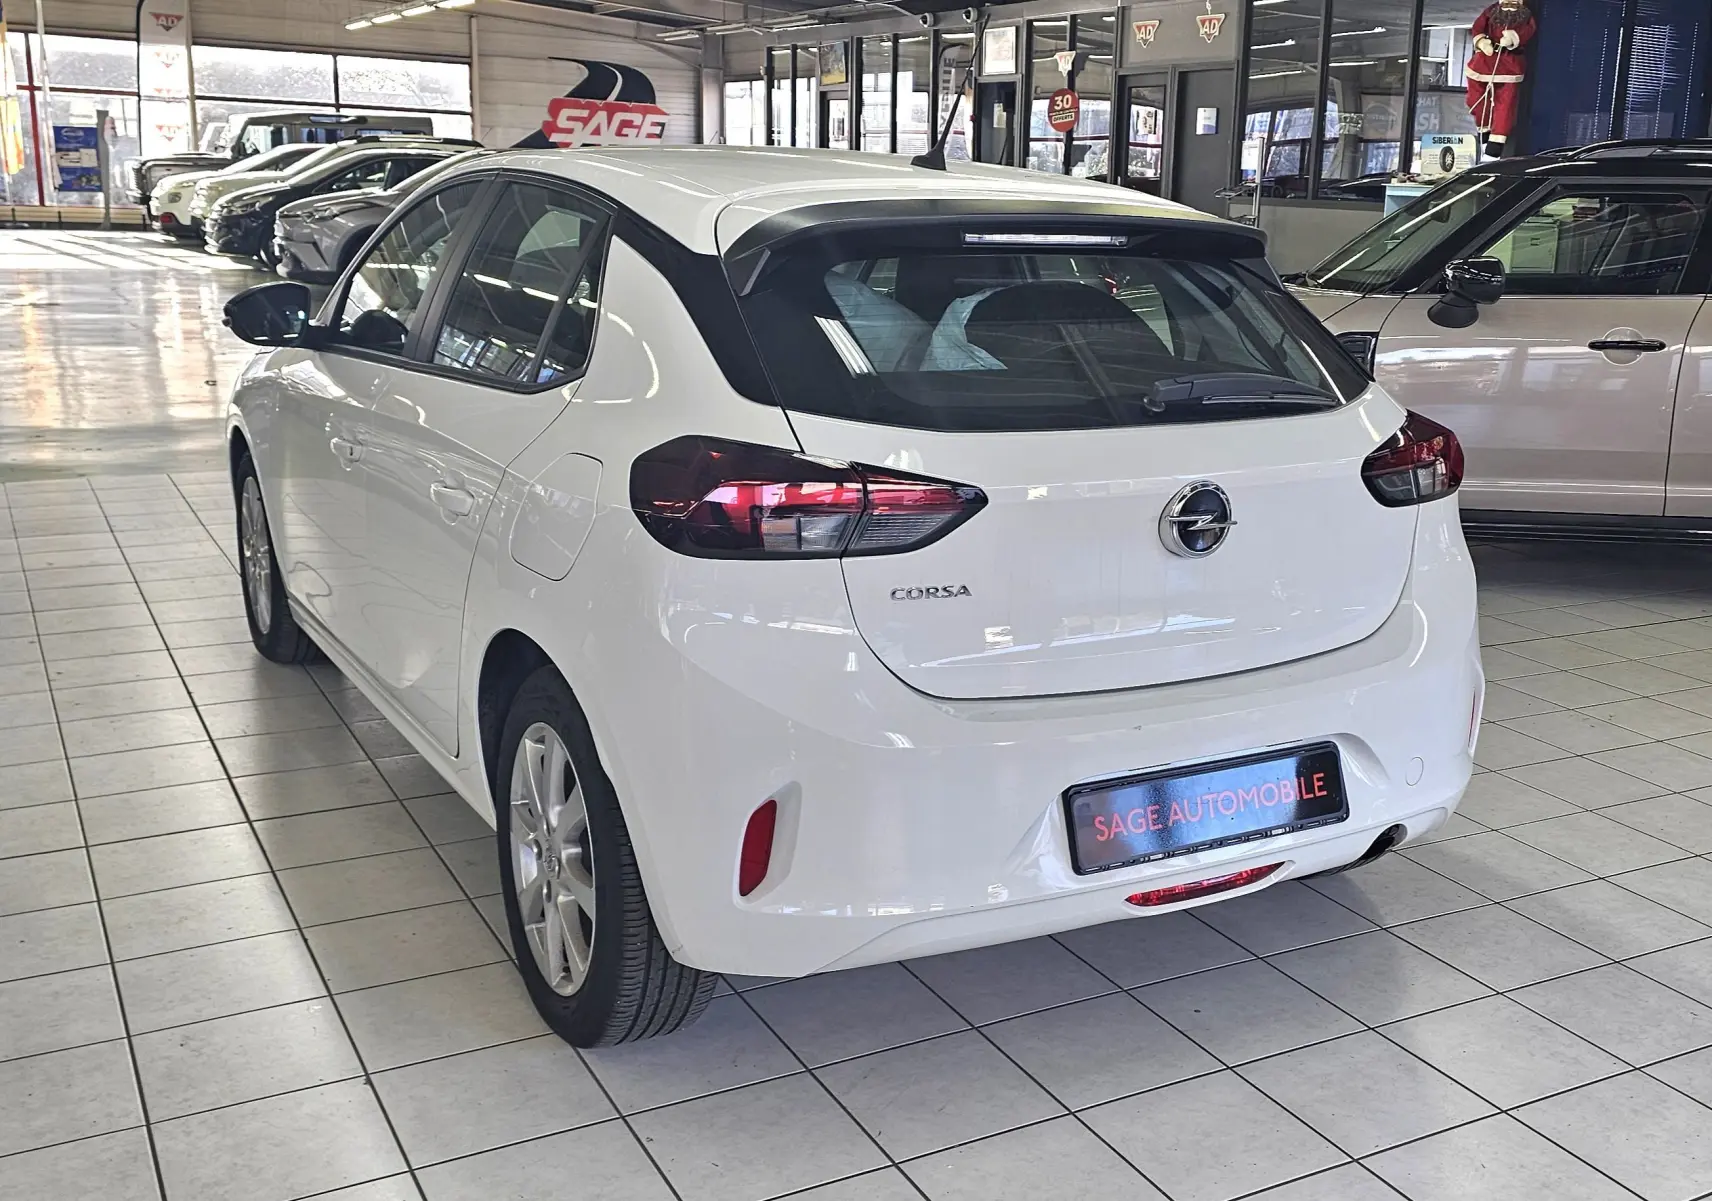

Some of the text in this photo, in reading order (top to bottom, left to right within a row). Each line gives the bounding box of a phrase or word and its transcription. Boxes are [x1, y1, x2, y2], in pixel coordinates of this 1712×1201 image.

[158, 15, 178, 26] AD
[1203, 19, 1218, 34] AD
[1140, 25, 1153, 40] AD
[1053, 94, 1072, 110] 30
[1053, 113, 1073, 122] OFFERTS
[549, 108, 669, 147] SAGE
[890, 584, 972, 600] CORSA
[1094, 772, 1328, 841] SAGE AUTOMOBILE
